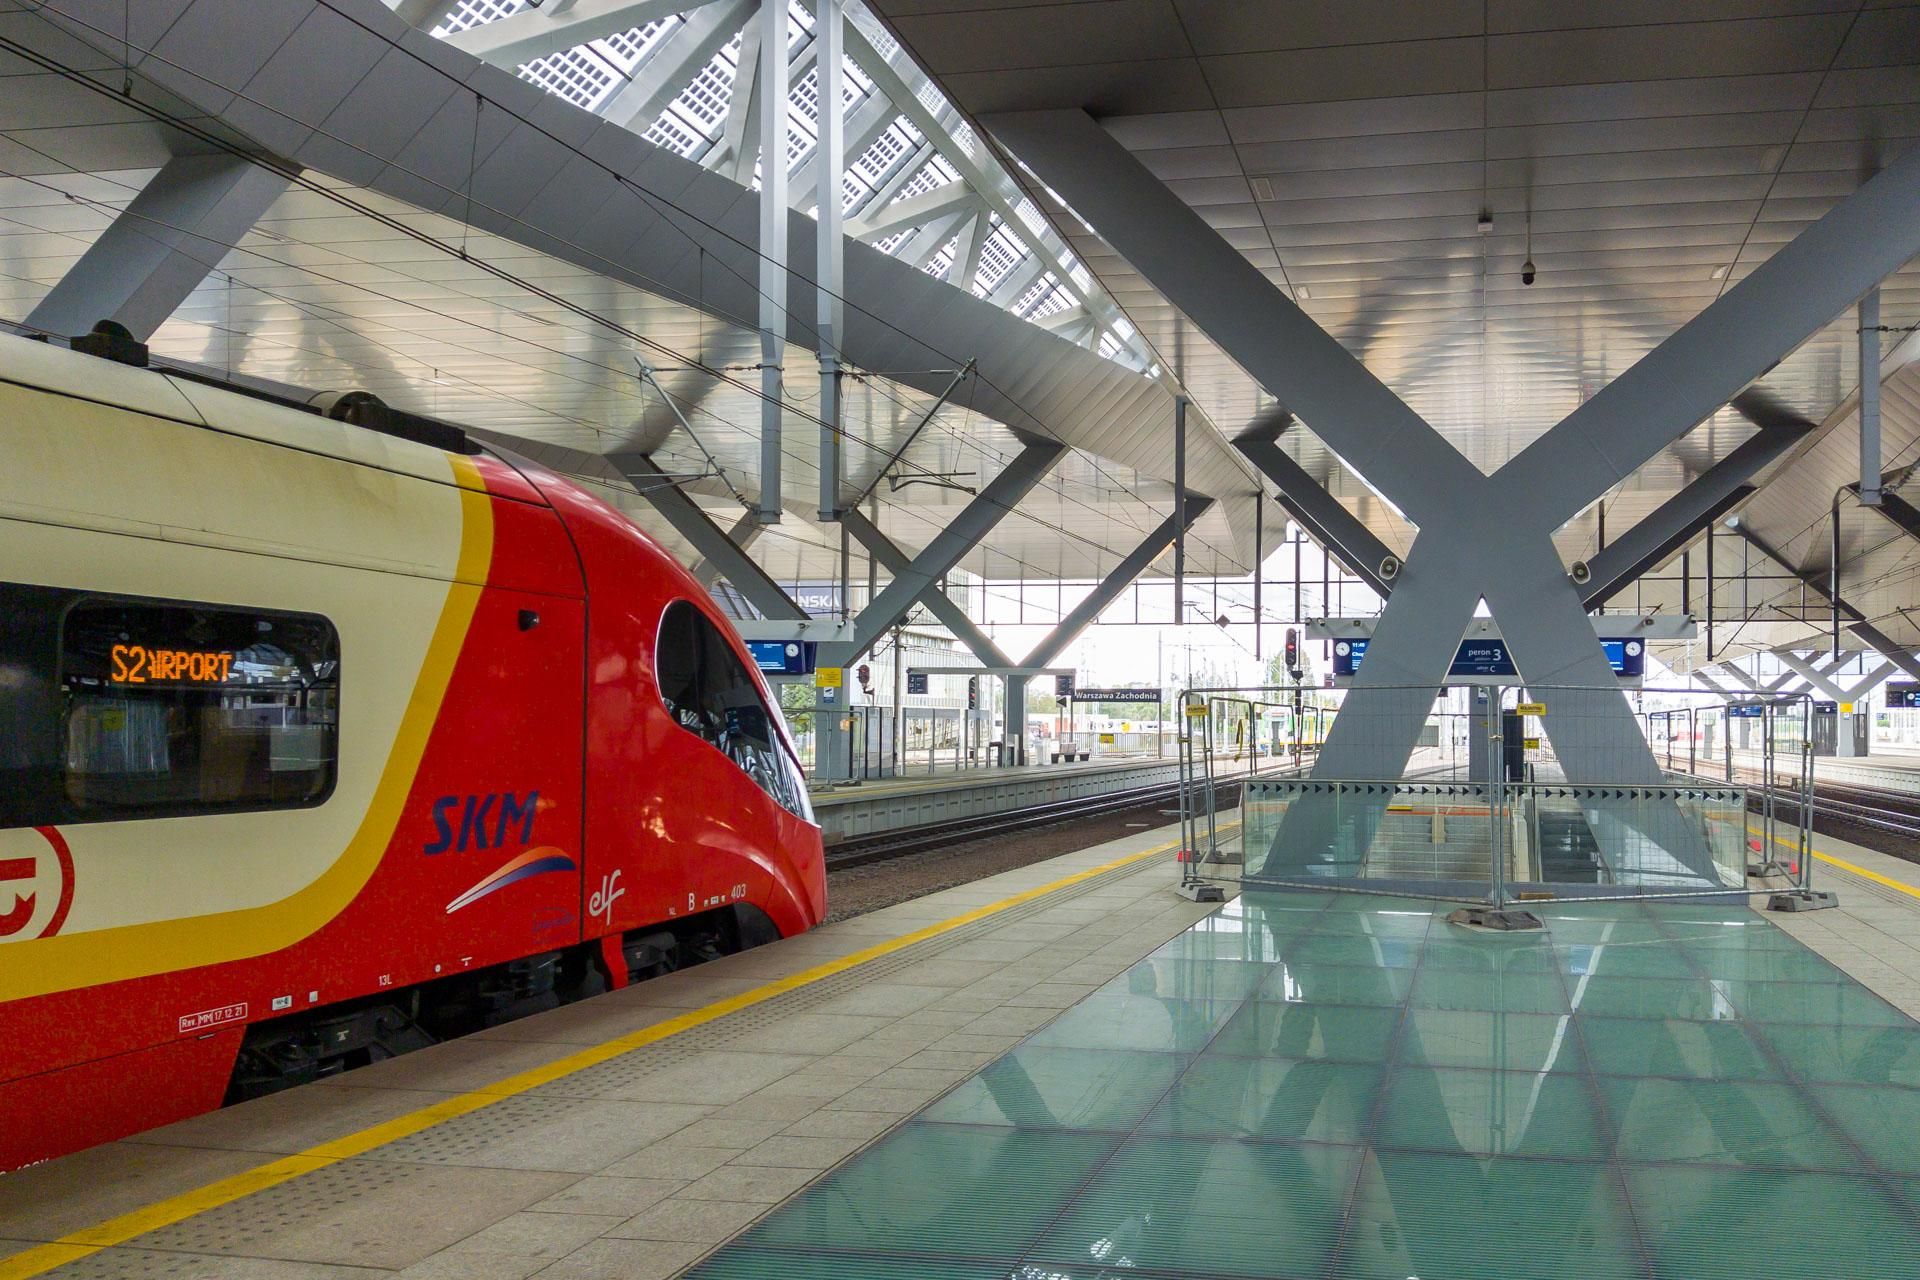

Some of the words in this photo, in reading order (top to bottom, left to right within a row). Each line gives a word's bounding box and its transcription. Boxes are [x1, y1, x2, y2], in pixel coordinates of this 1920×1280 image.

[1468, 648, 1491, 657] peron
[1492, 648, 1502, 661] 3
[112, 645, 146, 682] S2
[1489, 665, 1497, 673] C
[1075, 692, 1114, 700] Warszawa
[1115, 691, 1157, 700] Zachodnia
[424, 791, 539, 855] SKM
[589, 869, 625, 926] elf
[688, 892, 696, 911] B
[181, 1018, 198, 1028] Rev.
